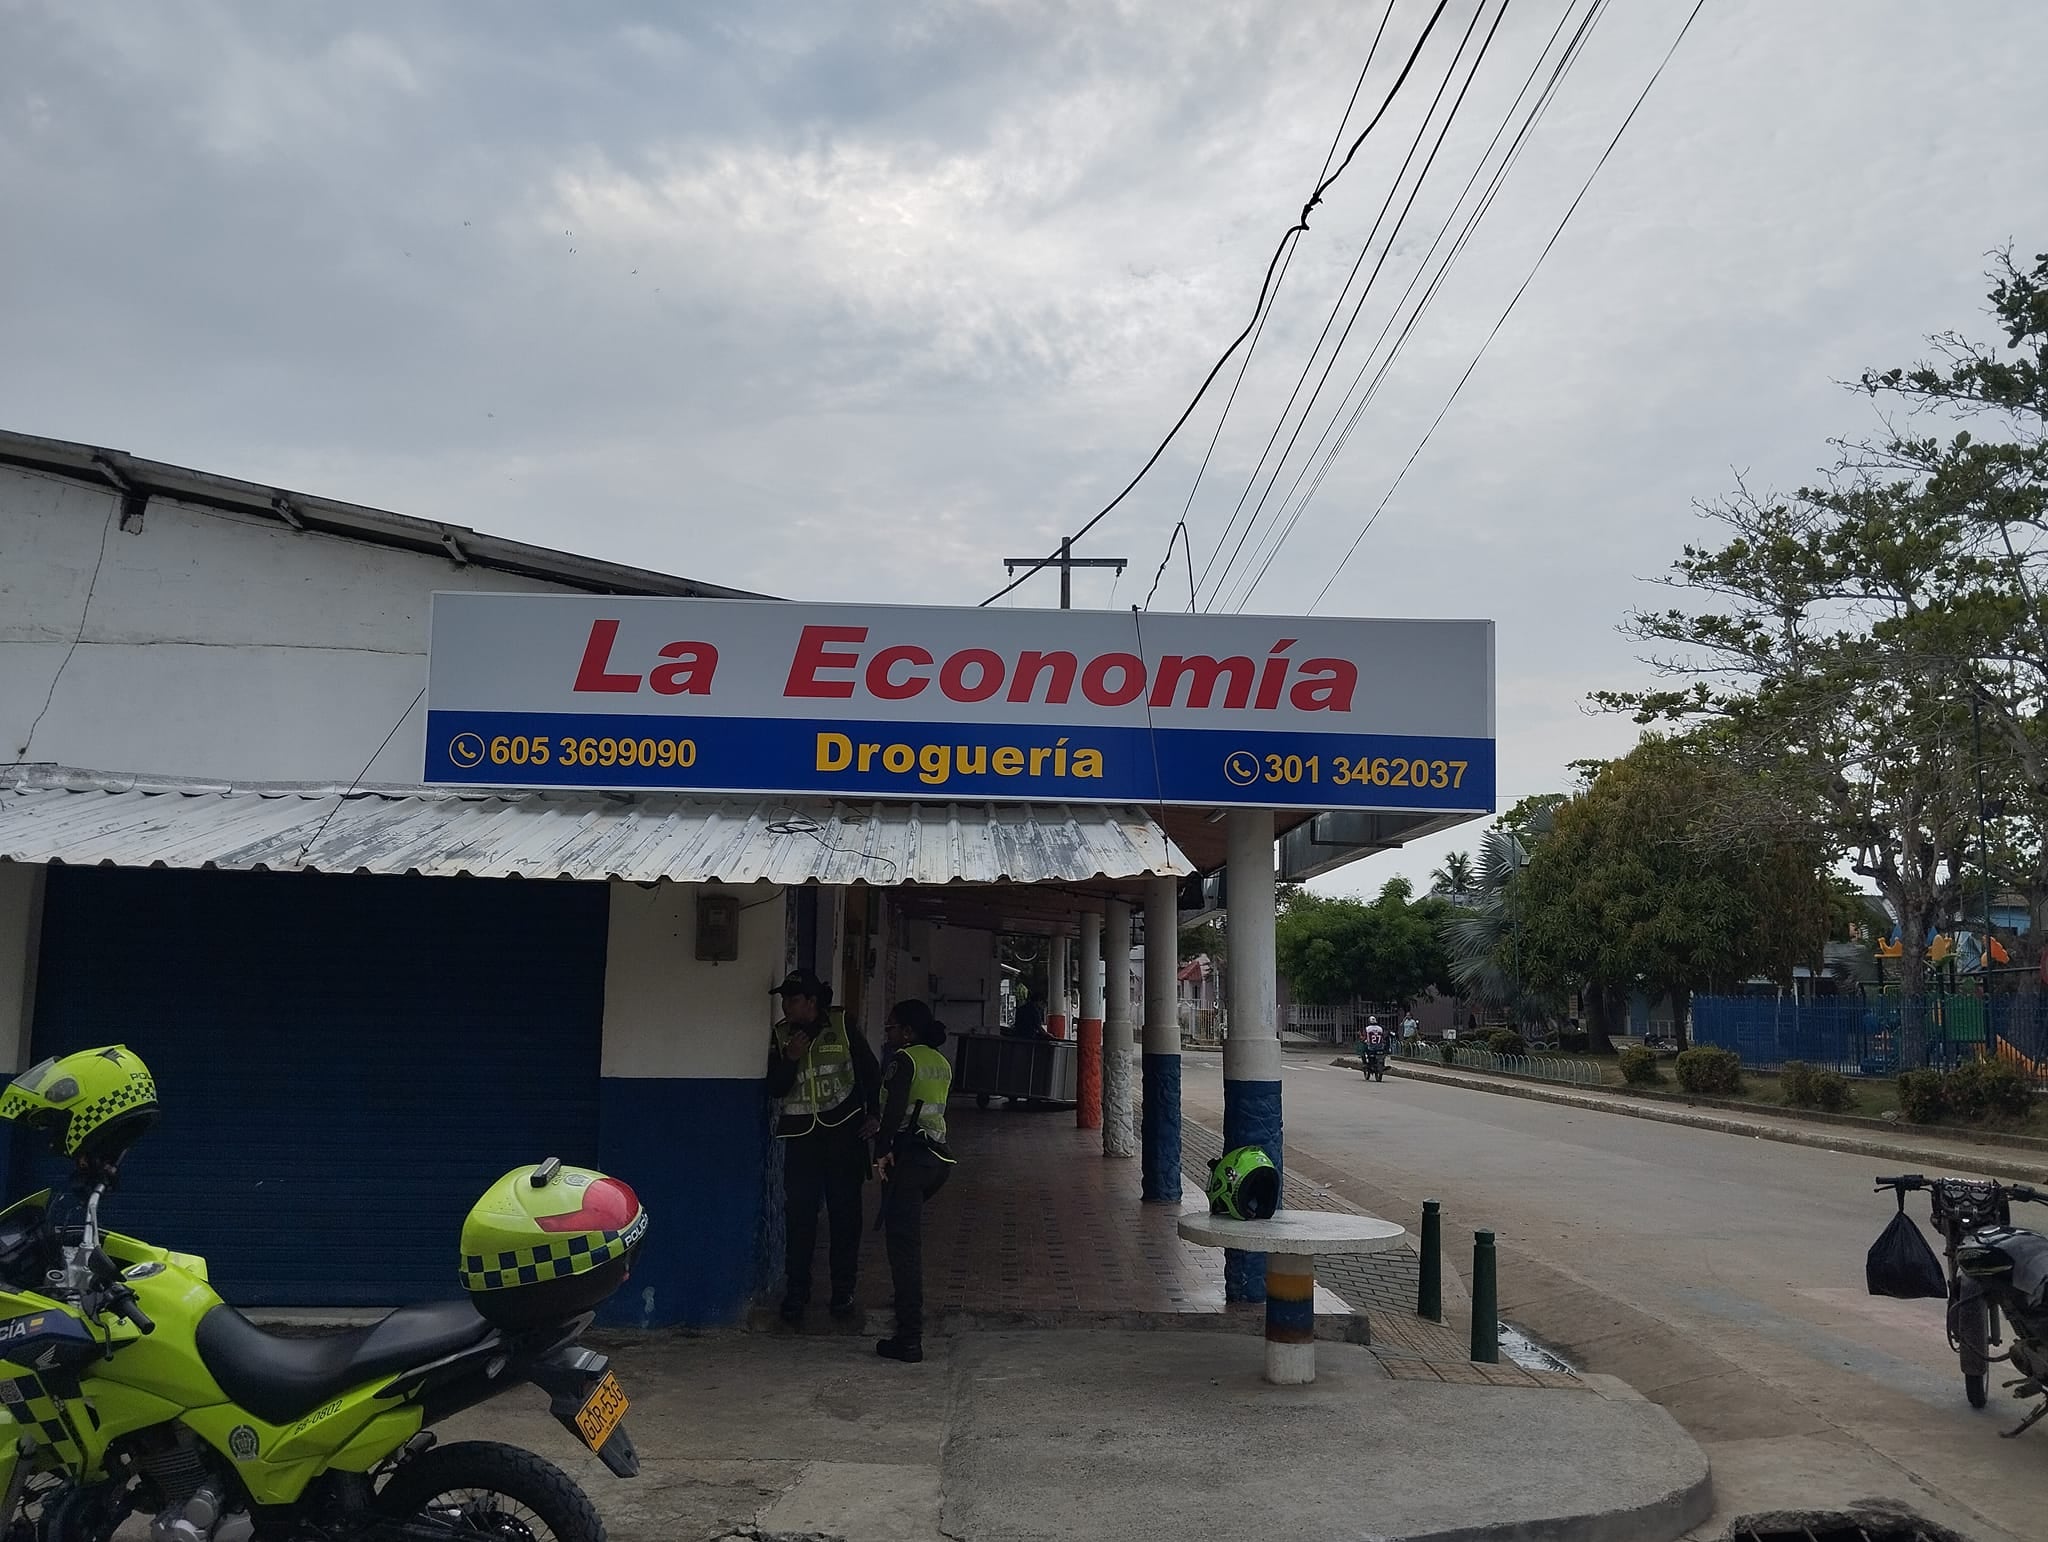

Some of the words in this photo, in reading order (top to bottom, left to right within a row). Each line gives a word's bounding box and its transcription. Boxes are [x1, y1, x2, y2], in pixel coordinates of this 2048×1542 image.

[574, 620, 718, 695] La
[784, 625, 1357, 712] Economía
[490, 736, 550, 766] 605
[559, 738, 697, 768] 3699090
[815, 732, 1104, 785] Droguería
[1264, 754, 1319, 784] 301
[1332, 757, 1468, 788] 3462037
[1371, 1034, 1382, 1044] 27
